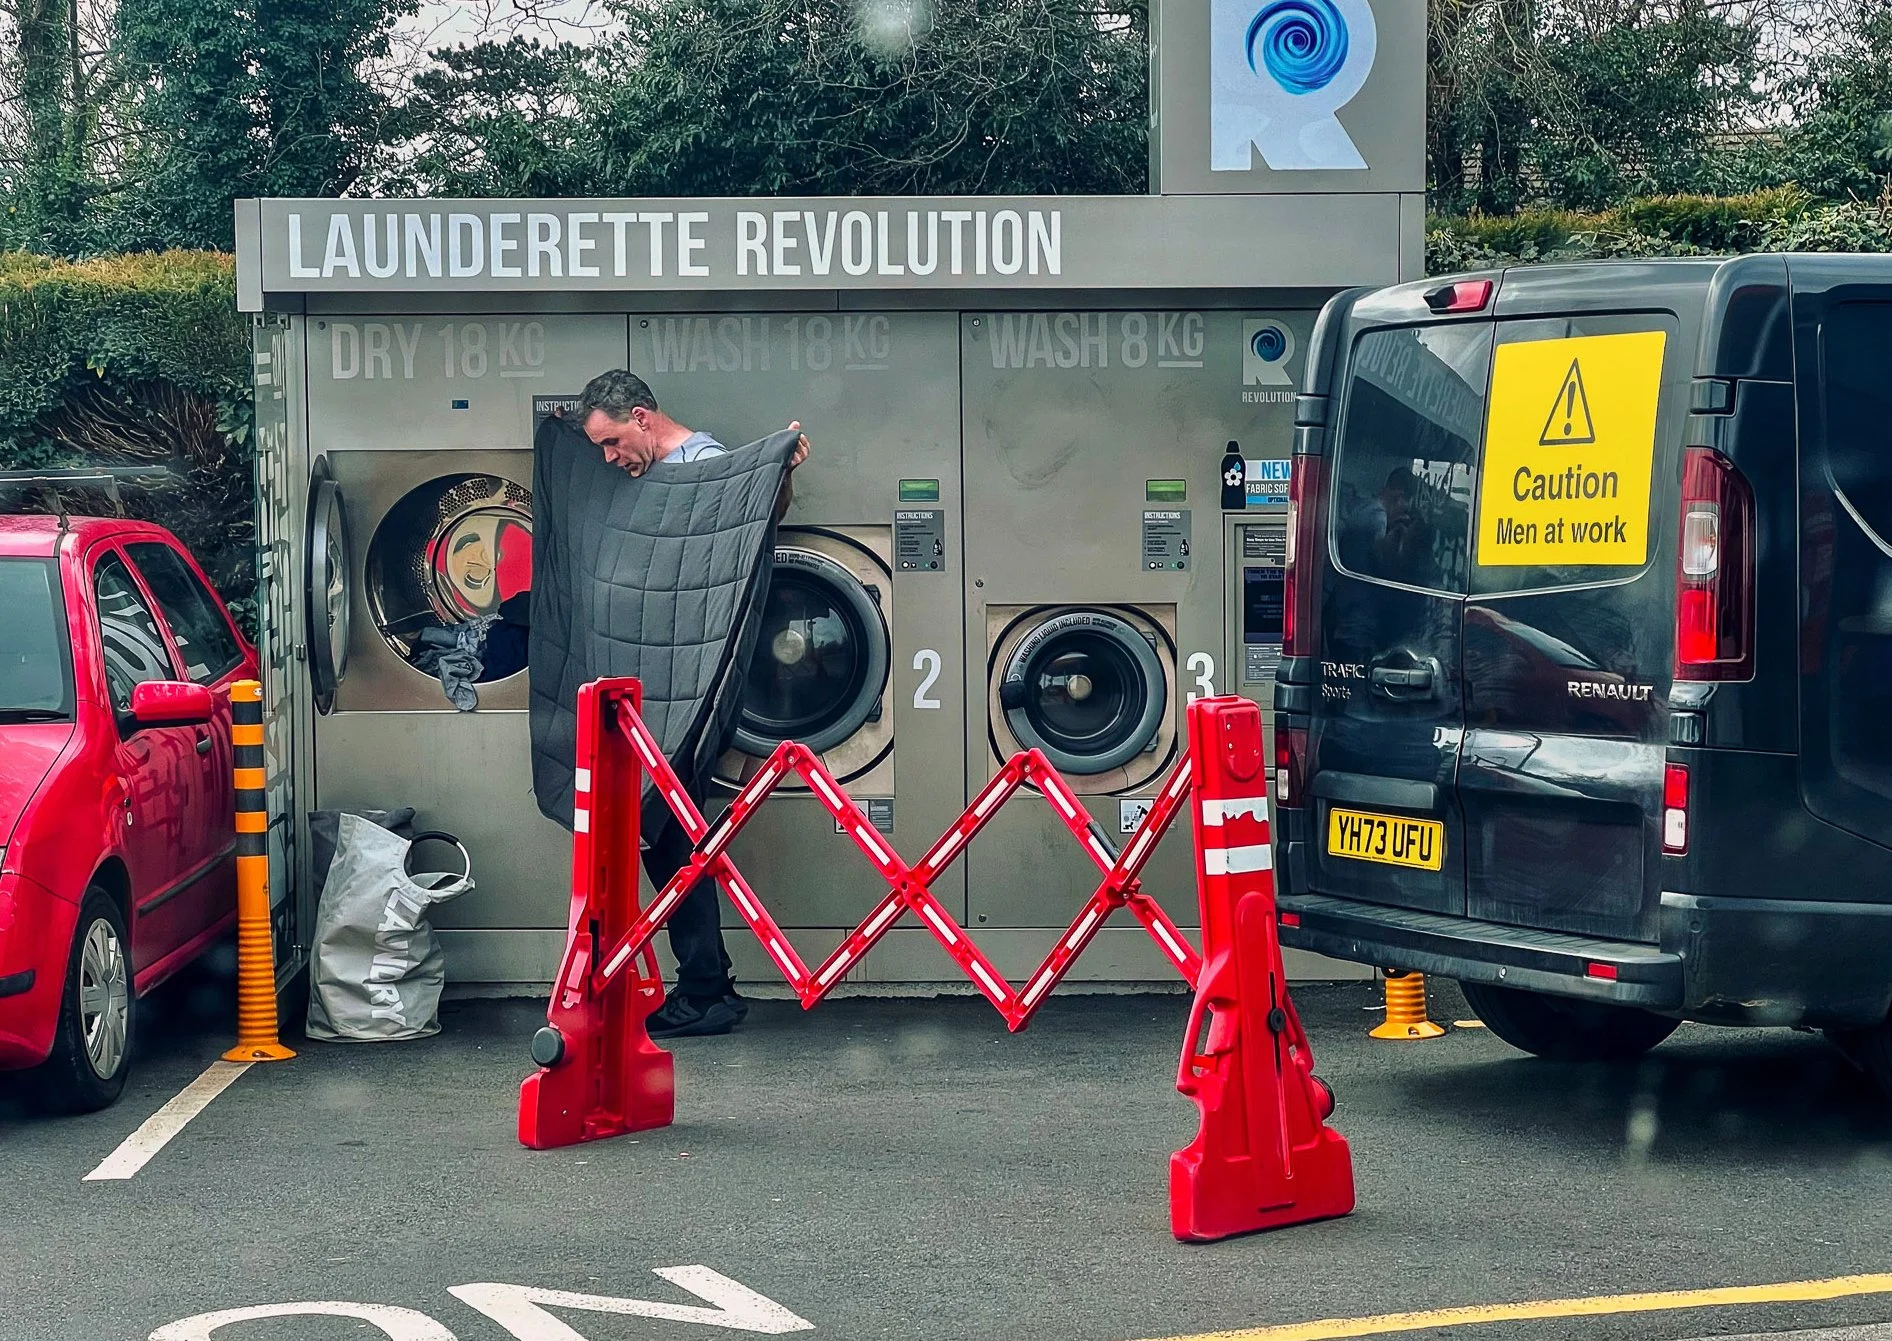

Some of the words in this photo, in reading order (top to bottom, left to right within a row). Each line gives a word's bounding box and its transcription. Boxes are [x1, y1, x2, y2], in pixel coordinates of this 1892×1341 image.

[288, 211, 709, 279] LAUNDERETTE
[736, 209, 1062, 276] REVOLUTION
[331, 322, 424, 379] DRY
[438, 321, 488, 379] 18
[499, 321, 545, 367] KG
[651, 317, 771, 373] WASH
[783, 316, 833, 372] 18
[844, 315, 890, 360] KG
[986, 312, 1108, 368] WASH
[1121, 311, 1148, 368] 8
[1157, 311, 1204, 357] KG
[1242, 391, 1296, 403] REVOLUTION
[1246, 483, 1273, 494] FABRIC
[1274, 483, 1289, 494] SOF
[1513, 464, 1619, 502] Caution
[896, 511, 934, 520] INSTRUCTIONS
[1144, 511, 1181, 520] INSTRUCTIONS
[1496, 517, 1537, 545] Men
[1544, 517, 1565, 544] at
[1571, 514, 1627, 544] work
[1018, 635, 1041, 664] WASHING
[1039, 623, 1059, 640] LIQUID
[1059, 616, 1091, 629] INCLUDED
[911, 649, 941, 709] 2
[1186, 651, 1215, 705] 3
[1320, 661, 1365, 679] TRAFIC
[1567, 681, 1654, 701] RENAULT
[1338, 814, 1388, 855] YH73
[1392, 822, 1433, 862] UFU
